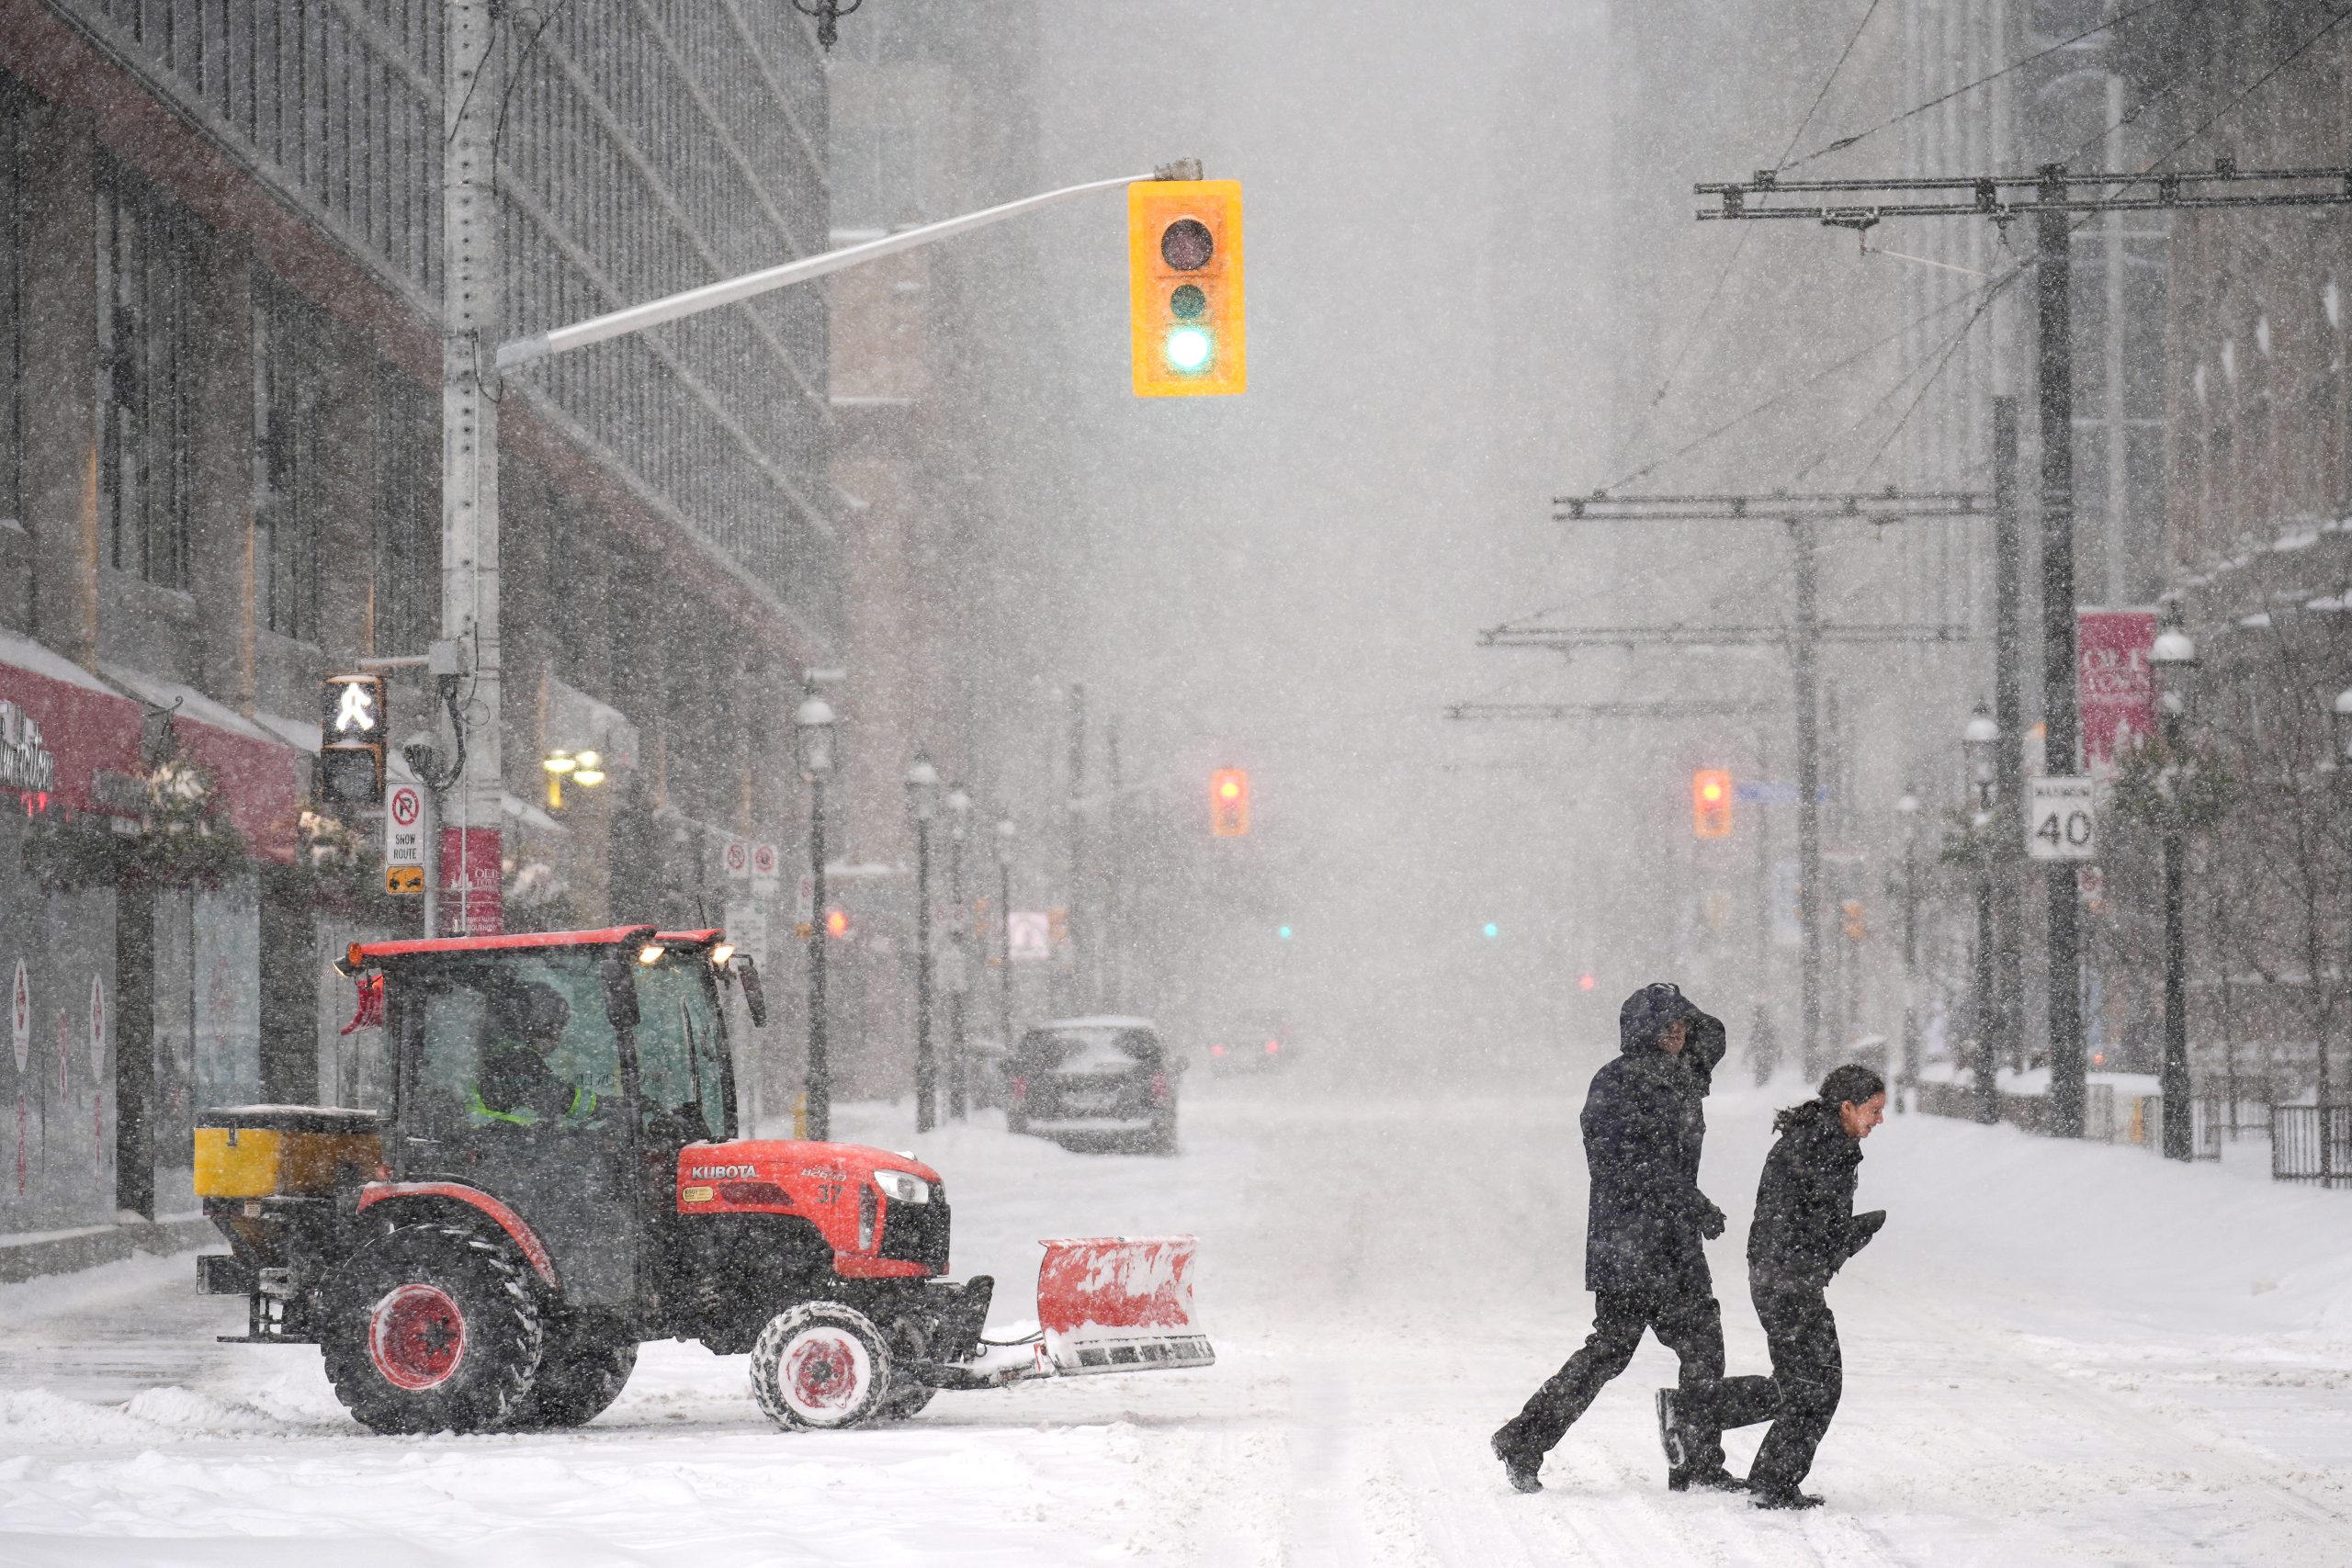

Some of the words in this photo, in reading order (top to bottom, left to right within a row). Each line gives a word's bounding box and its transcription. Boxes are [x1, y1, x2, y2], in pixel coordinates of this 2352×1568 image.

[2036, 810, 2091, 846] 40
[395, 833, 416, 846] SNOW
[393, 848, 417, 860] ROUTE
[692, 1165, 756, 1179] KUBOTA
[816, 1183, 843, 1204] 37
